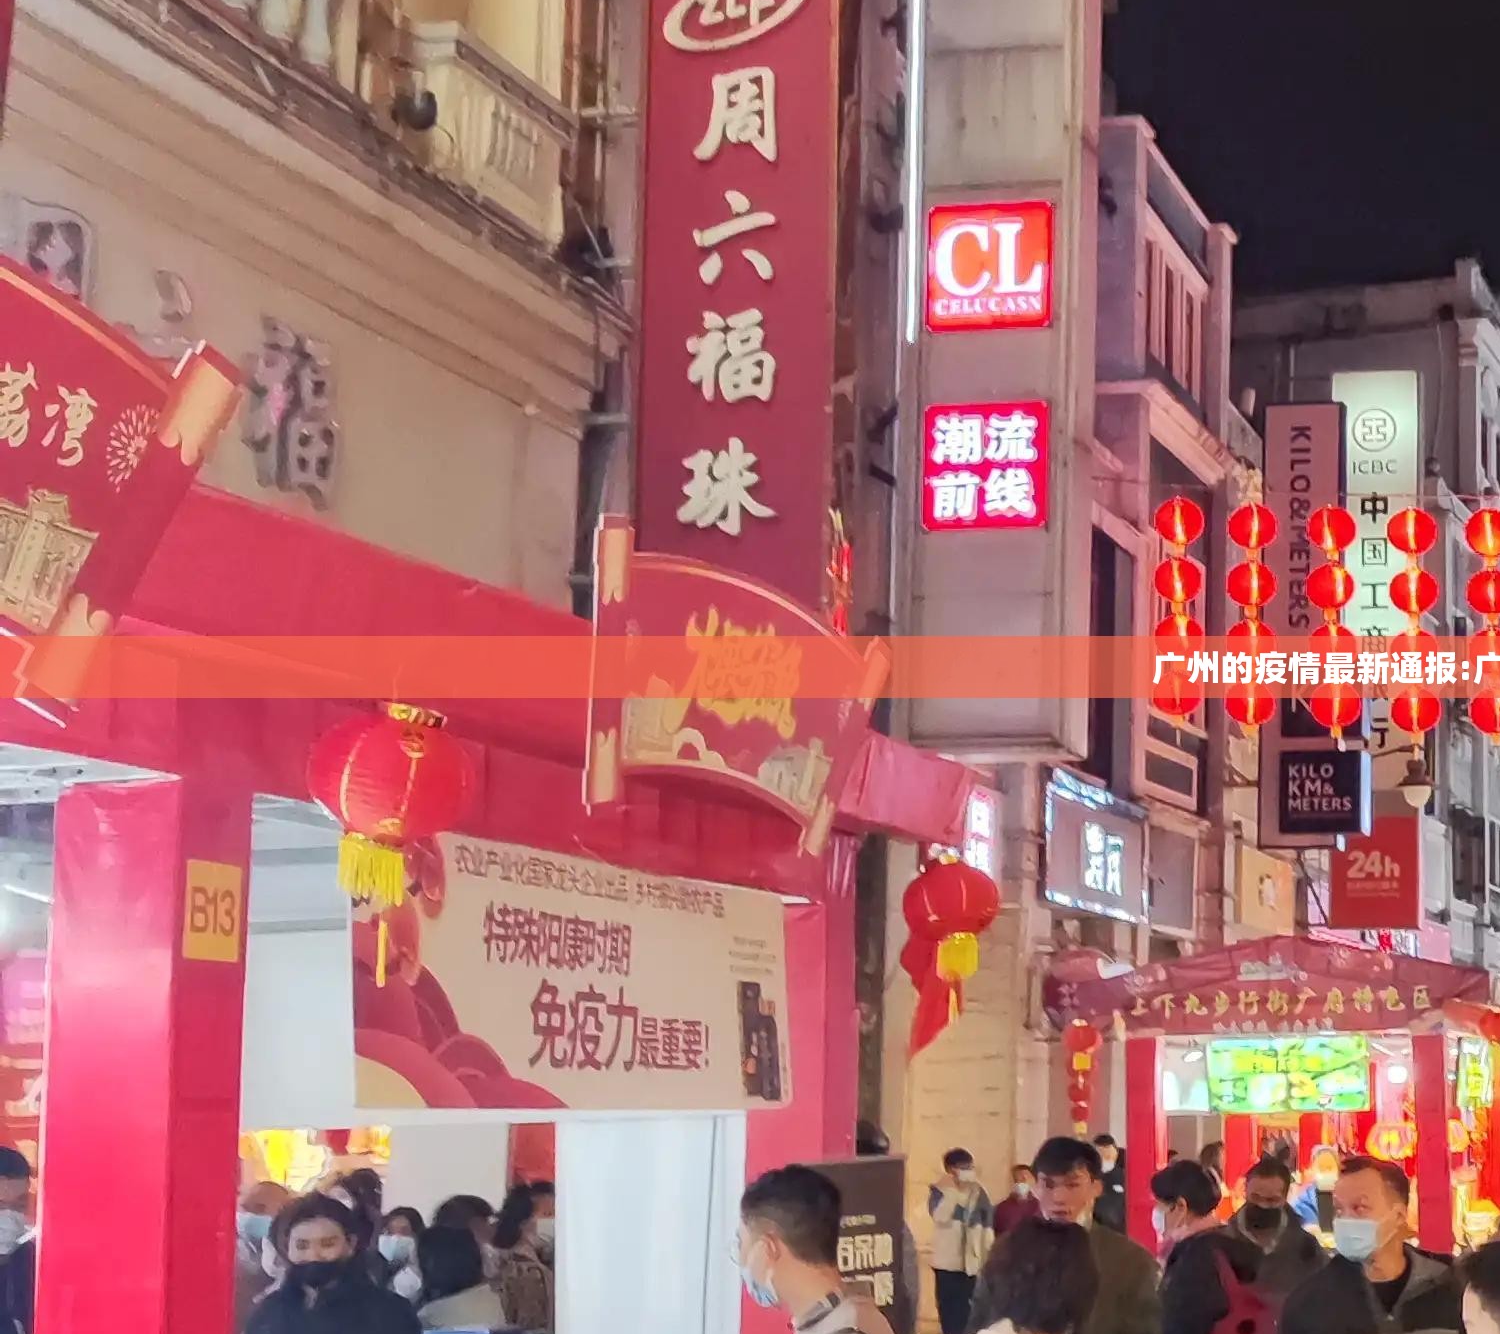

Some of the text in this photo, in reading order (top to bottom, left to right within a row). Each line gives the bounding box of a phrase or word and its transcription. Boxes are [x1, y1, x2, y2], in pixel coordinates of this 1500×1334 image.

[934, 217, 1044, 298] CL
[676, 66, 777, 536] 周六福珠
[931, 415, 1038, 465] 潮流
[1352, 460, 1398, 476] ICBC
[931, 469, 1036, 521] 前线
[1288, 763, 1335, 779] KILO
[1288, 795, 1353, 812] METERS
[1347, 850, 1401, 879] 24h
[189, 886, 235, 937] B13
